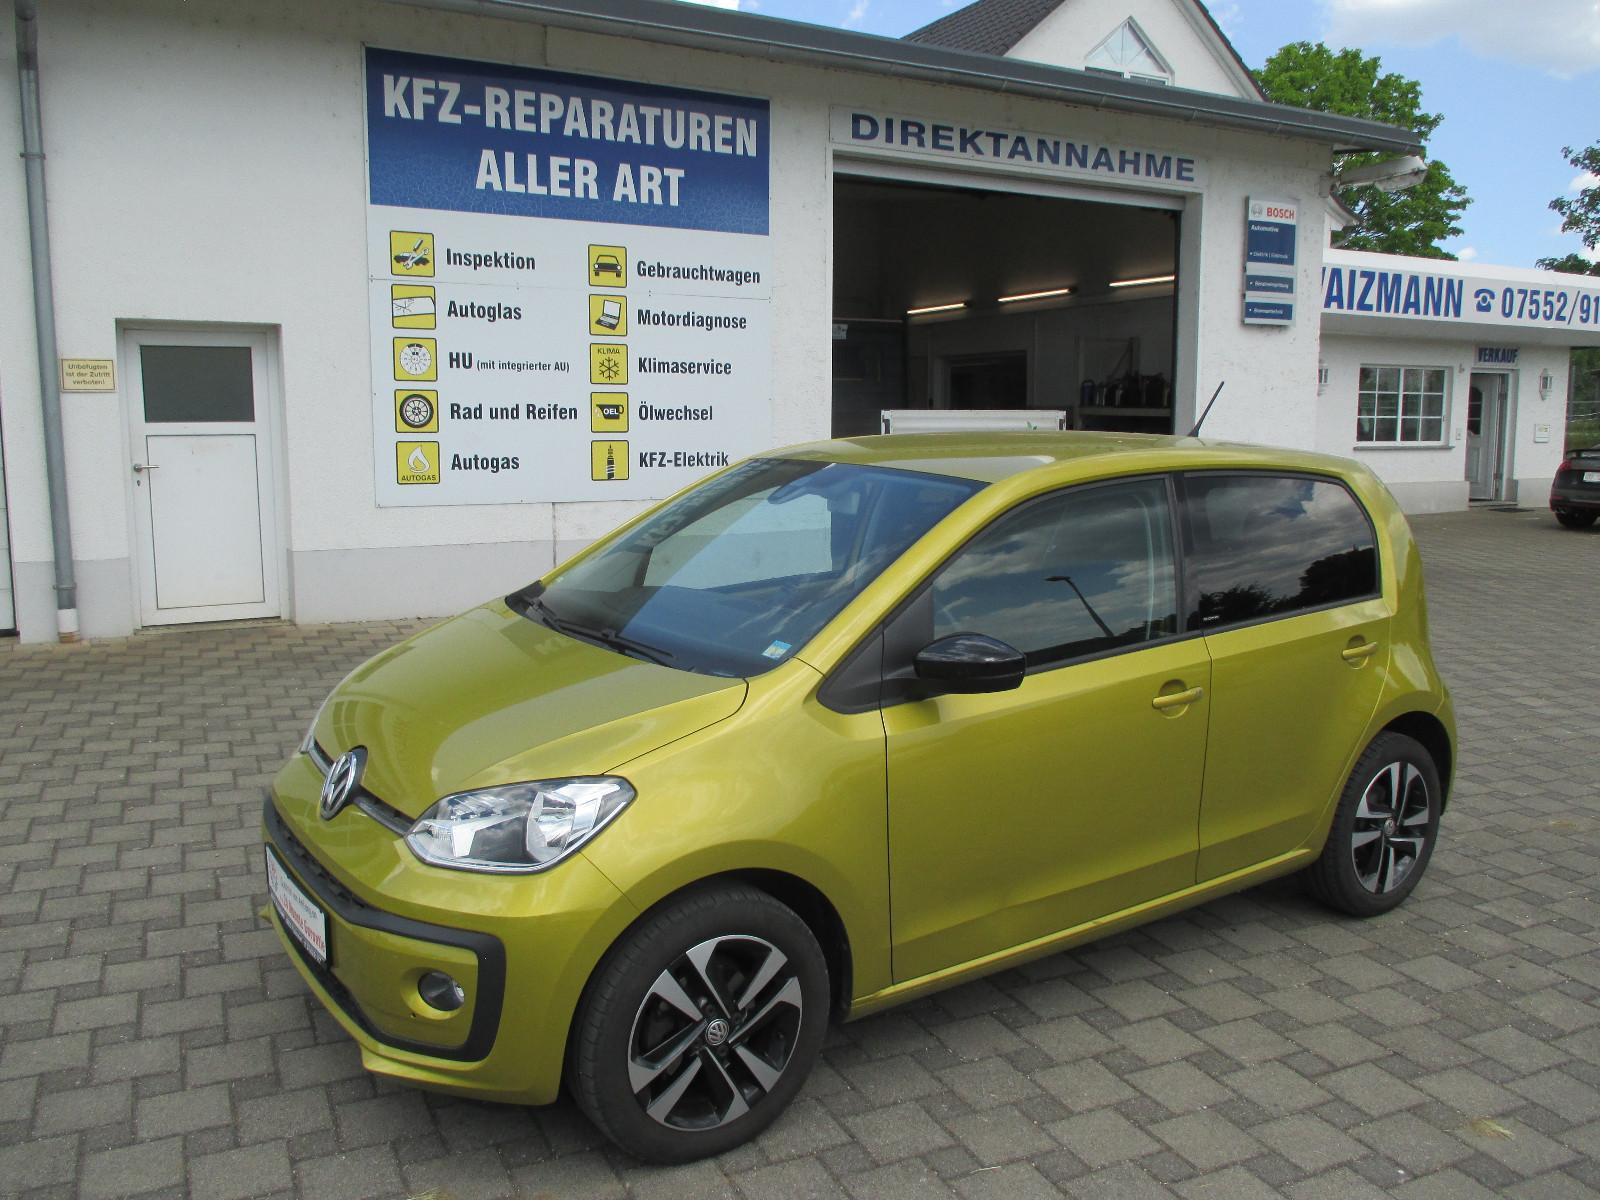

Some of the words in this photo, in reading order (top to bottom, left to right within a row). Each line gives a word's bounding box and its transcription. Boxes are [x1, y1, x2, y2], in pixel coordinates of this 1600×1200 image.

[383, 74, 757, 157] KFZ-REPARATUREN
[851, 113, 1195, 183] DIREKTANNAHME
[475, 149, 599, 200] ALLER
[613, 163, 685, 207] ART
[1266, 207, 1295, 220] BOSCH
[446, 248, 536, 272] Inspektion
[637, 261, 761, 286] Gebrauchtwagen
[447, 301, 522, 322] Autoglas
[637, 309, 748, 331] Motordiagnose
[598, 347, 620, 355] KLIMA
[1478, 347, 1518, 363] VERKAUF
[448, 352, 473, 370] HU
[476, 360, 495, 371] (mit
[499, 360, 551, 372] integrierter
[554, 361, 570, 373] AU)
[638, 358, 732, 376] Klimaservice
[450, 403, 482, 420] Rad
[489, 403, 519, 420] und
[526, 403, 578, 420] Reifen
[638, 404, 713, 422] Ölwechsel
[451, 453, 520, 473] Autogas
[639, 451, 729, 468] KFZ-Elektrik
[401, 474, 437, 482] AUTOGAS
